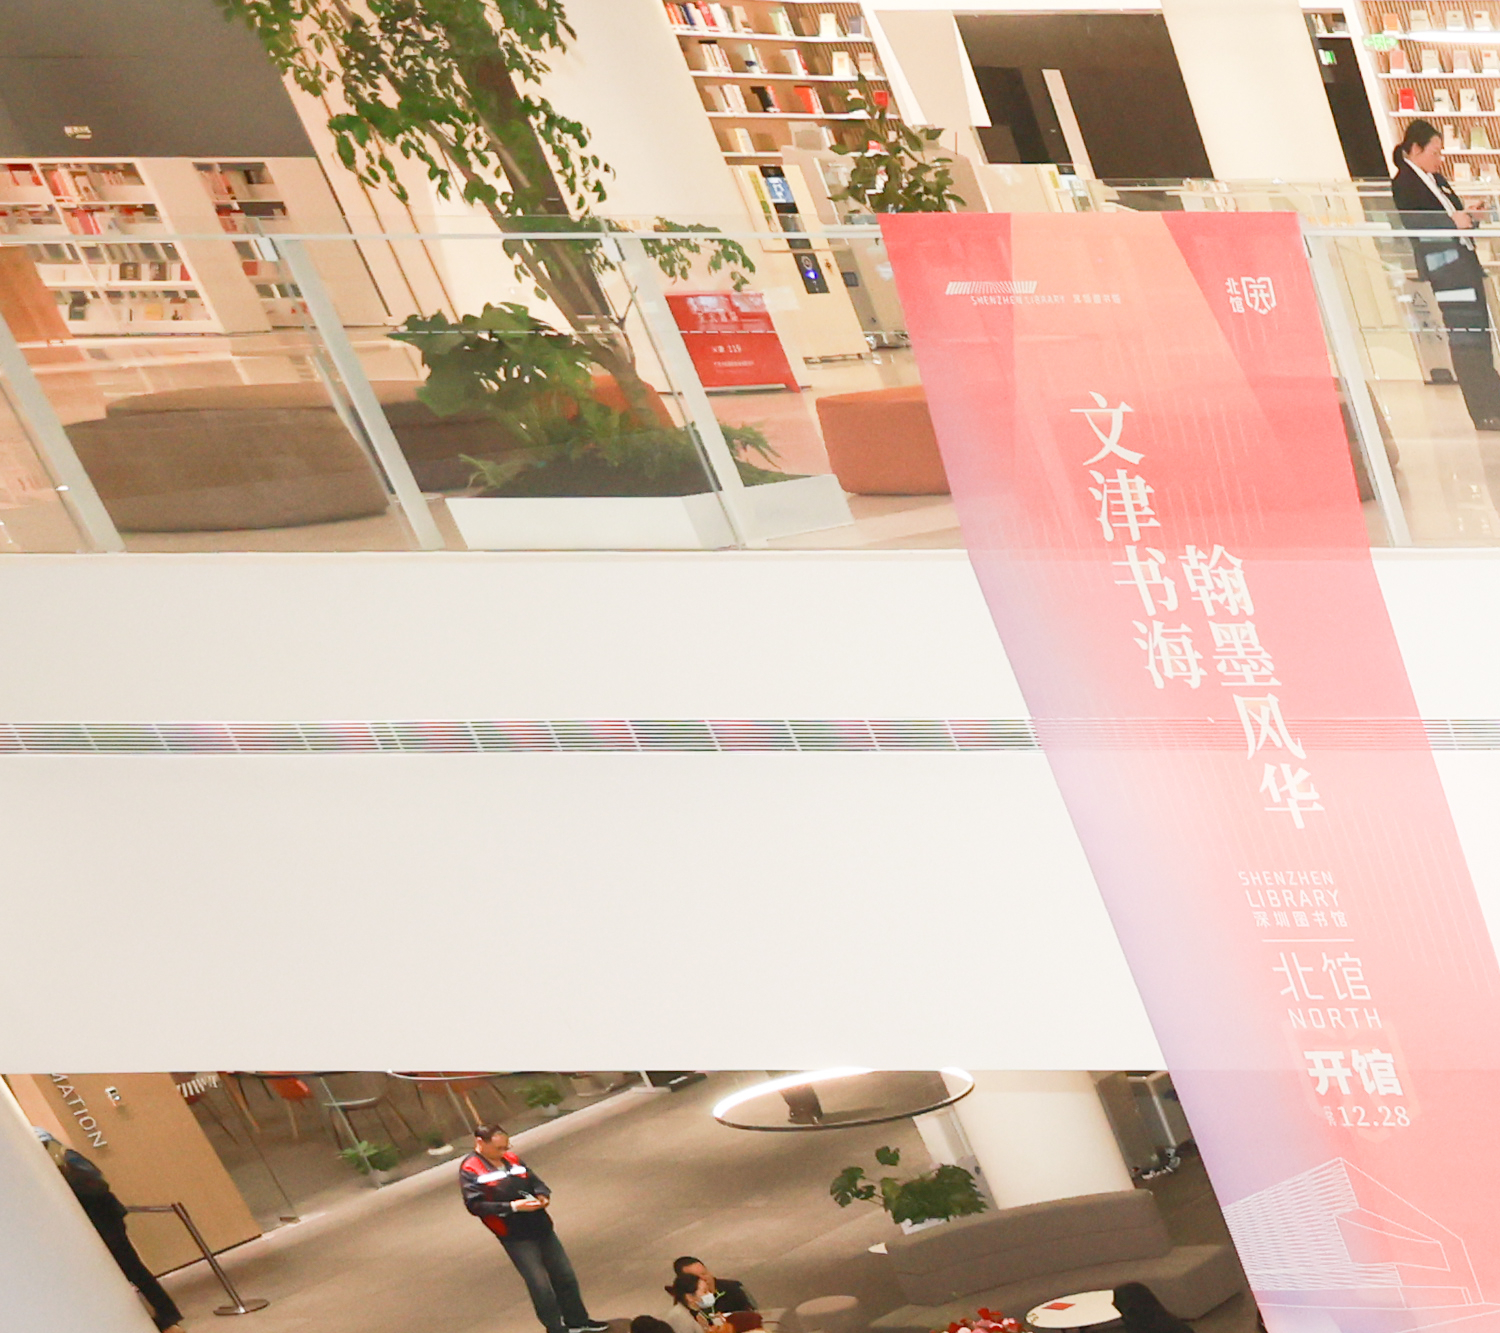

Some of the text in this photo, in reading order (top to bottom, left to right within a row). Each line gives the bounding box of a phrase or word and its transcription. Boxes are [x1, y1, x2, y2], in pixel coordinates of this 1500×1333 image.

[1226, 277, 1245, 314] 北馆
[1070, 390, 1209, 690] 文津书海
[1179, 543, 1326, 831] 翰墨风华
[1238, 869, 1334, 887] SHENZHEN
[1245, 889, 1341, 909] LIBRARY
[1252, 910, 1349, 929] 深圳图书馆
[1271, 952, 1371, 1003] 北馆
[1287, 1007, 1382, 1030] NORTH
[1304, 1047, 1405, 1098] 开馆
[1336, 1105, 1411, 1128] 12.28
